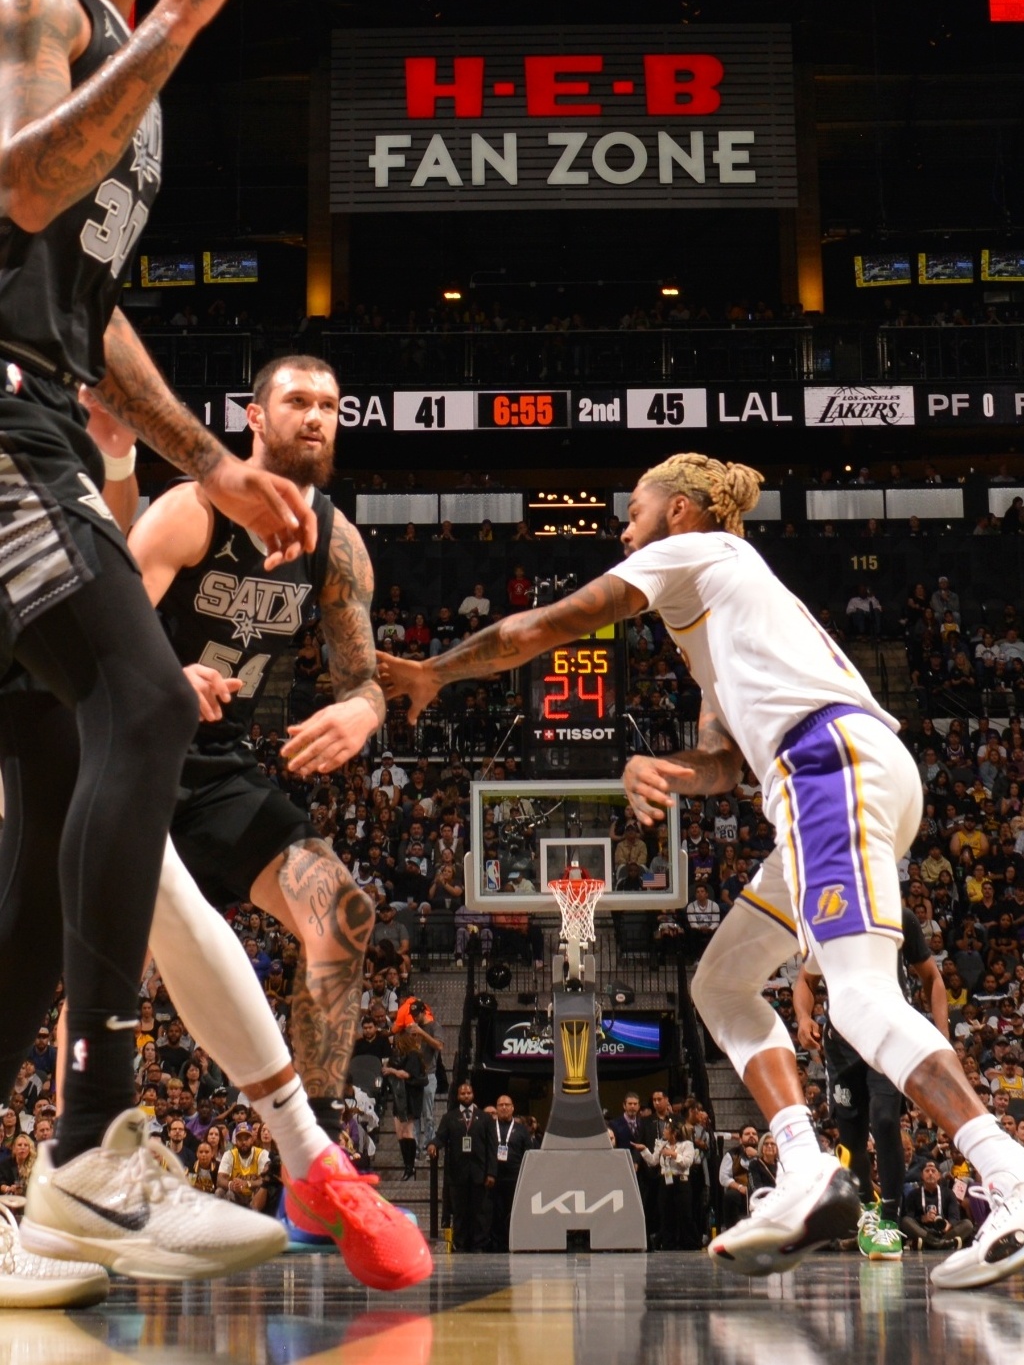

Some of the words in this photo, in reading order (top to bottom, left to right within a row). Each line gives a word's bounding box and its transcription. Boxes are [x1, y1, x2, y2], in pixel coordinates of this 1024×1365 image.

[368, 132, 518, 188] FAN
[547, 131, 757, 185] ZONE
[338, 395, 388, 427] SA
[414, 395, 446, 428] 41
[493, 395, 553, 426] 6:55
[578, 397, 621, 423] 2nd
[646, 393, 685, 425] 45
[718, 392, 793, 422] LAL
[814, 395, 901, 426] LAKERS
[928, 393, 970, 417] PF
[982, 393, 994, 418] 0
[851, 555, 878, 570] 115
[194, 570, 312, 636] SATX
[554, 650, 608, 674] 6:55
[543, 675, 603, 719] 24
[556, 728, 615, 740] TISSOT
